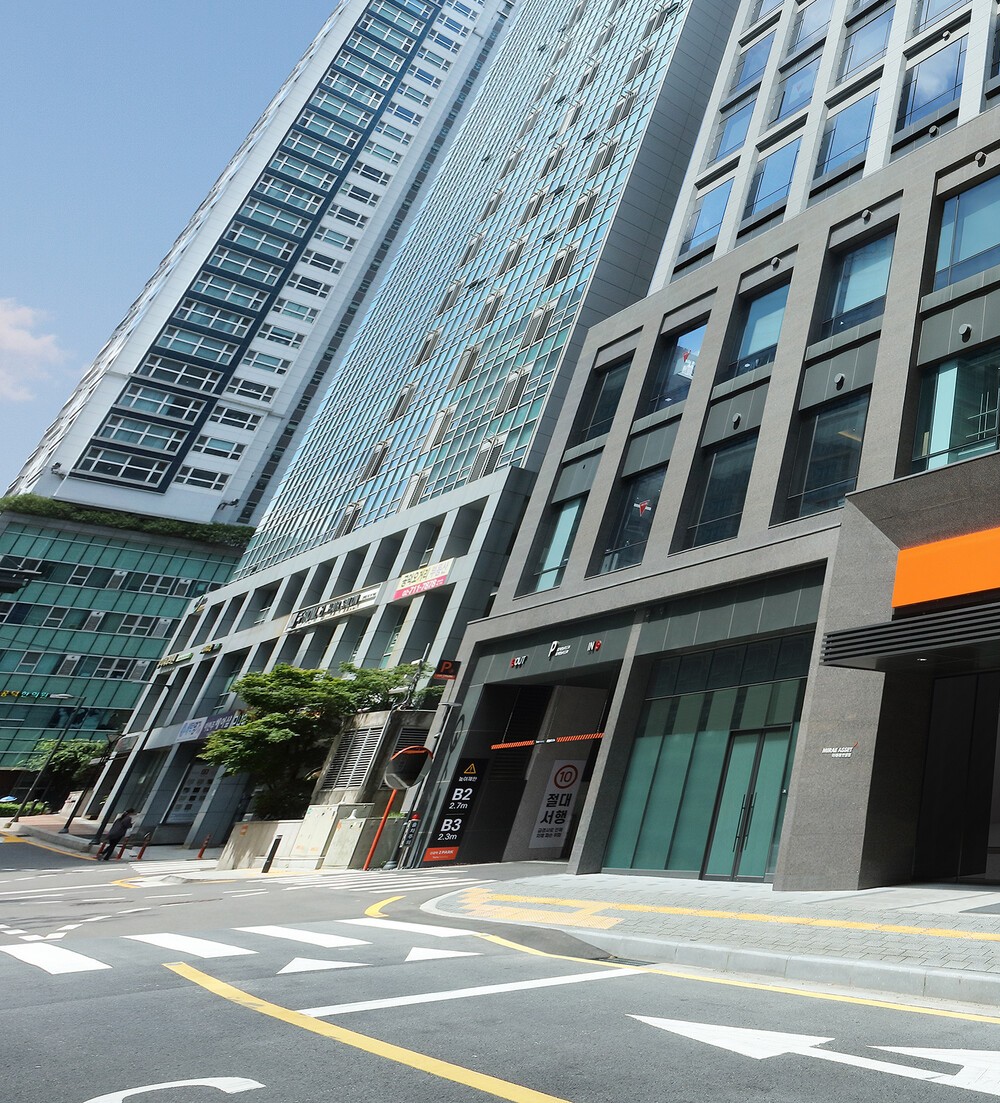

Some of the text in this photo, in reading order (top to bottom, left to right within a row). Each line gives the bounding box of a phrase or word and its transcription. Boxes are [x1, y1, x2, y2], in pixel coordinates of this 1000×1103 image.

[547, 640, 560, 658] P
[587, 641, 595, 652] IN
[514, 655, 527, 666] OUT
[441, 661, 452, 673] P
[559, 771, 573, 783] 10
[451, 787, 473, 801] B2
[449, 801, 468, 809] 2.7m
[546, 793, 573, 808] 절대
[540, 810, 568, 825] 서행
[441, 818, 462, 832] B3
[437, 833, 458, 841] 2.3m
